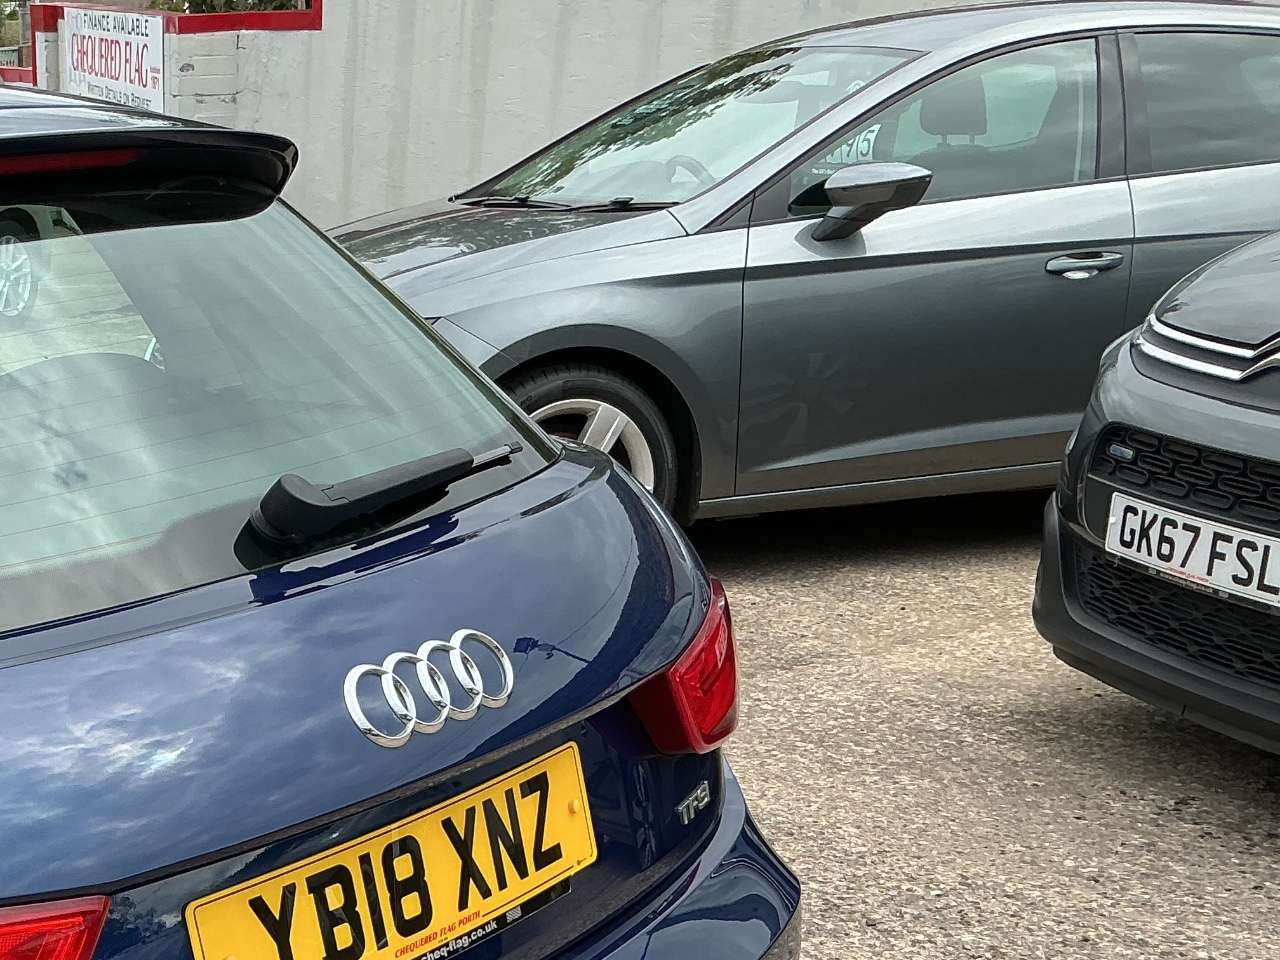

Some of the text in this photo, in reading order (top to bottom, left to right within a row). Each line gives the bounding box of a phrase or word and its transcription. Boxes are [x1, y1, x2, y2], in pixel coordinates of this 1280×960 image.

[83, 13, 149, 37] FINANCE AVAILABLE
[71, 33, 149, 88] CHEQUERED FLAG
[1119, 504, 1280, 596] GK67 FSL
[441, 770, 563, 911] XNZ
[394, 910, 481, 959] CHEQUERED FLAG PORTH
